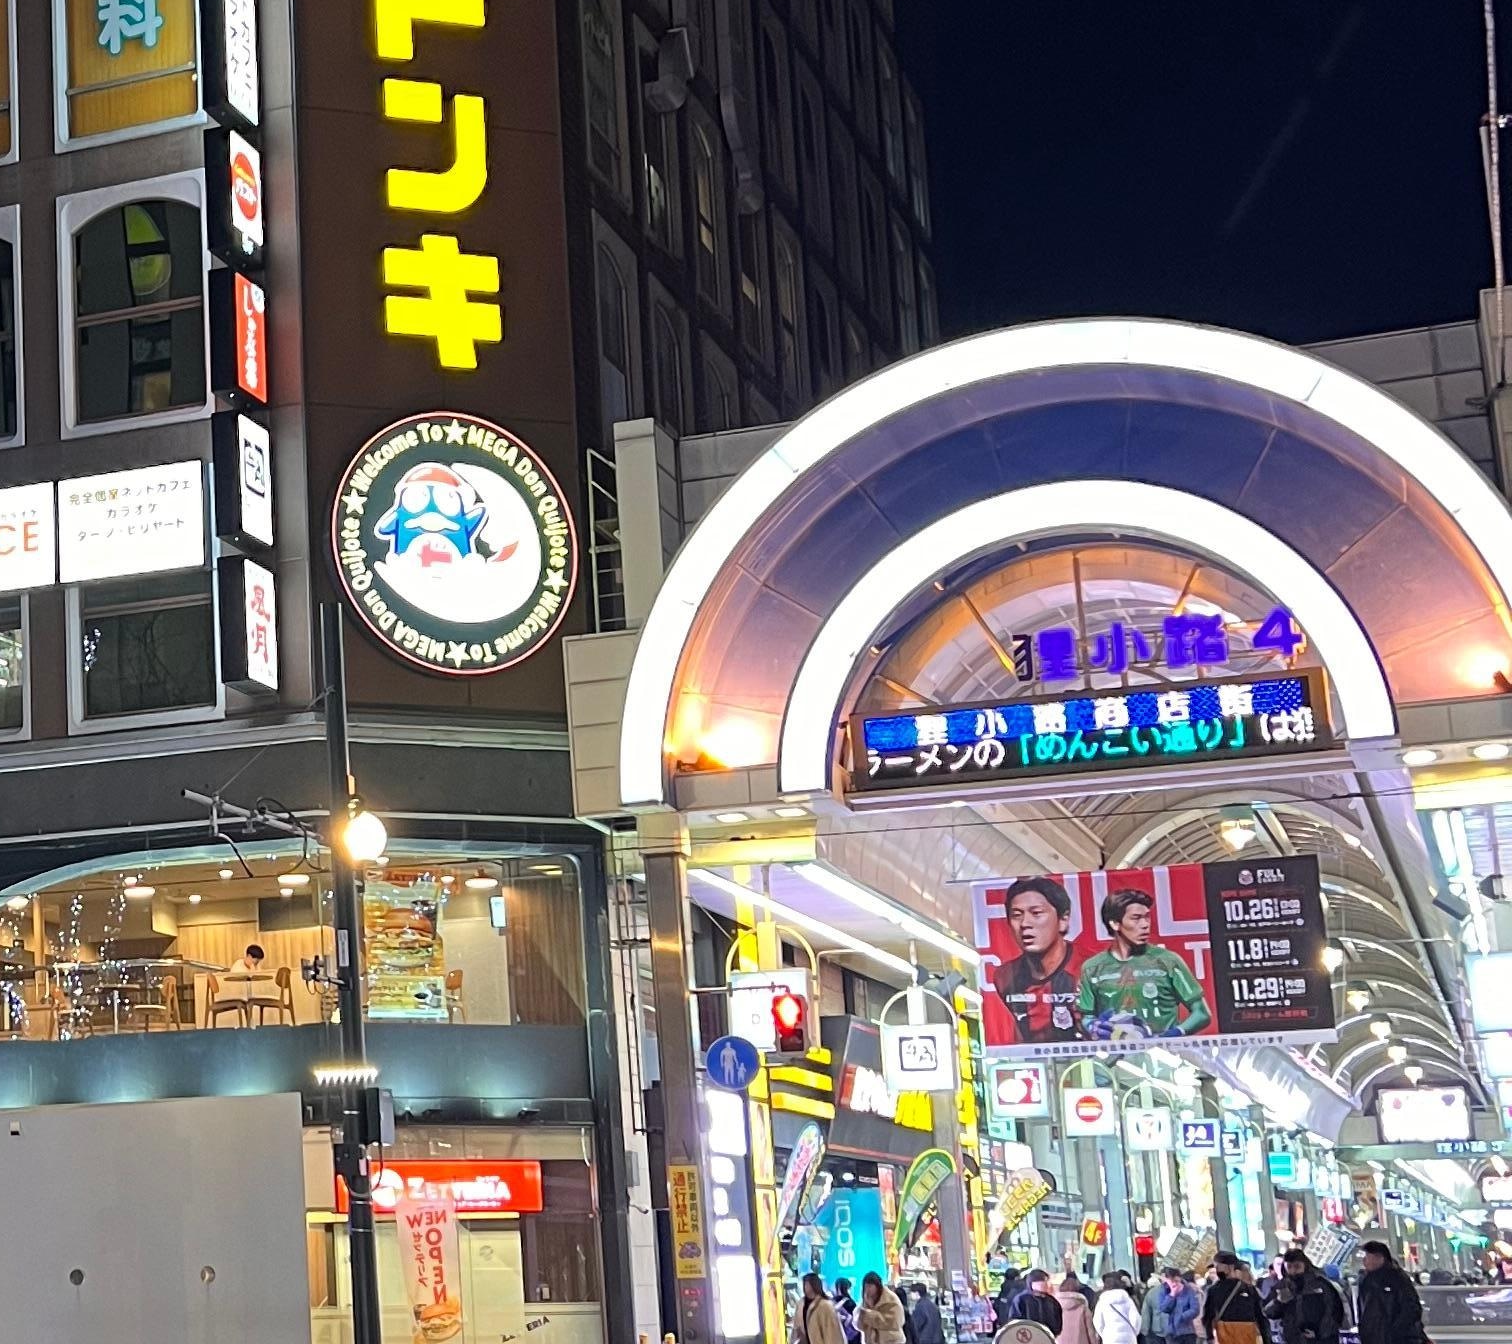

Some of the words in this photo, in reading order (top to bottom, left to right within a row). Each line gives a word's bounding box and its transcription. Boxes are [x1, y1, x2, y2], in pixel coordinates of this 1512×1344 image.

[349, 429, 421, 494] Welcome
[416, 422, 445, 443] To
[465, 424, 520, 468] MEGA
[513, 462, 549, 498] Don
[106, 502, 159, 520] カラオケ
